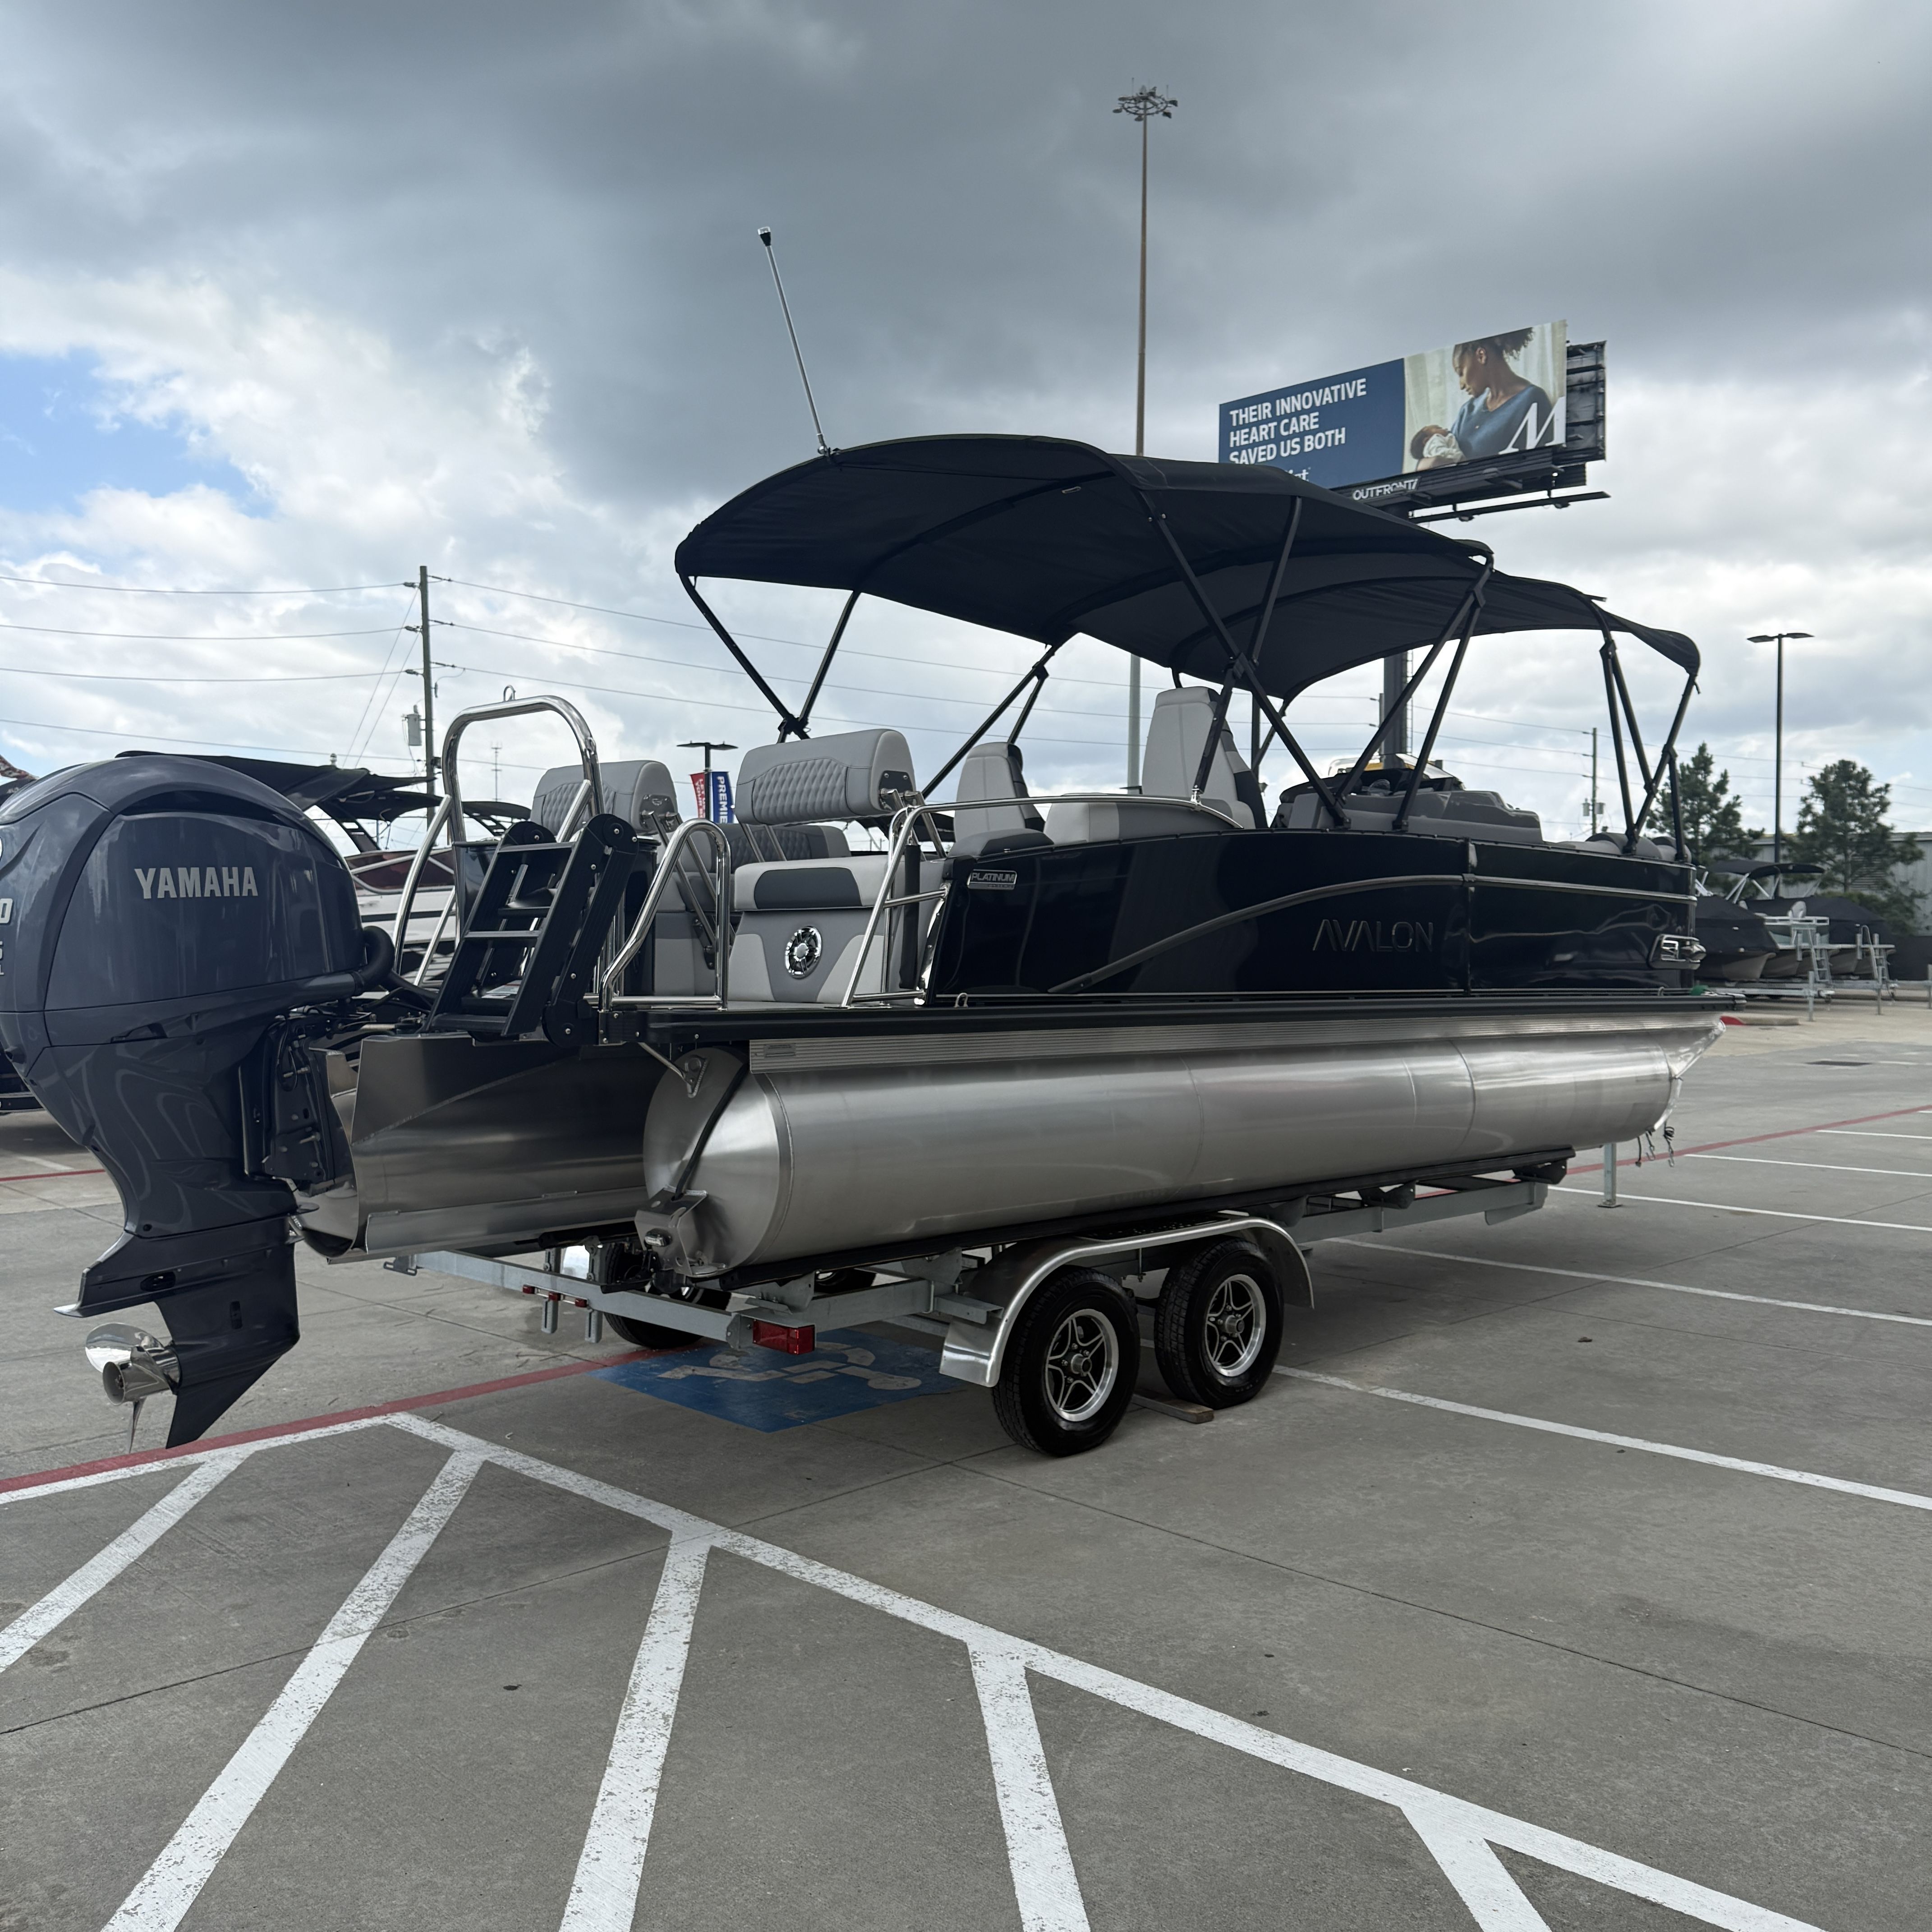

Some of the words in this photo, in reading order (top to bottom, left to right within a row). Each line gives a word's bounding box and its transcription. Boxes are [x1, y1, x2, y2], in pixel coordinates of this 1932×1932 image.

[1229, 402, 1272, 426] THEIR
[1276, 378, 1366, 416] INNOVATIVE
[1229, 422, 1277, 447] HEART
[1280, 412, 1319, 436] CARE
[1229, 444, 1277, 465] SAVED
[1280, 438, 1300, 457] US
[1303, 427, 1346, 452] BOTH
[134, 866, 258, 899] YAMAHA
[971, 872, 1015, 882] PLATINUM
[1312, 919, 1434, 952] AVALON
